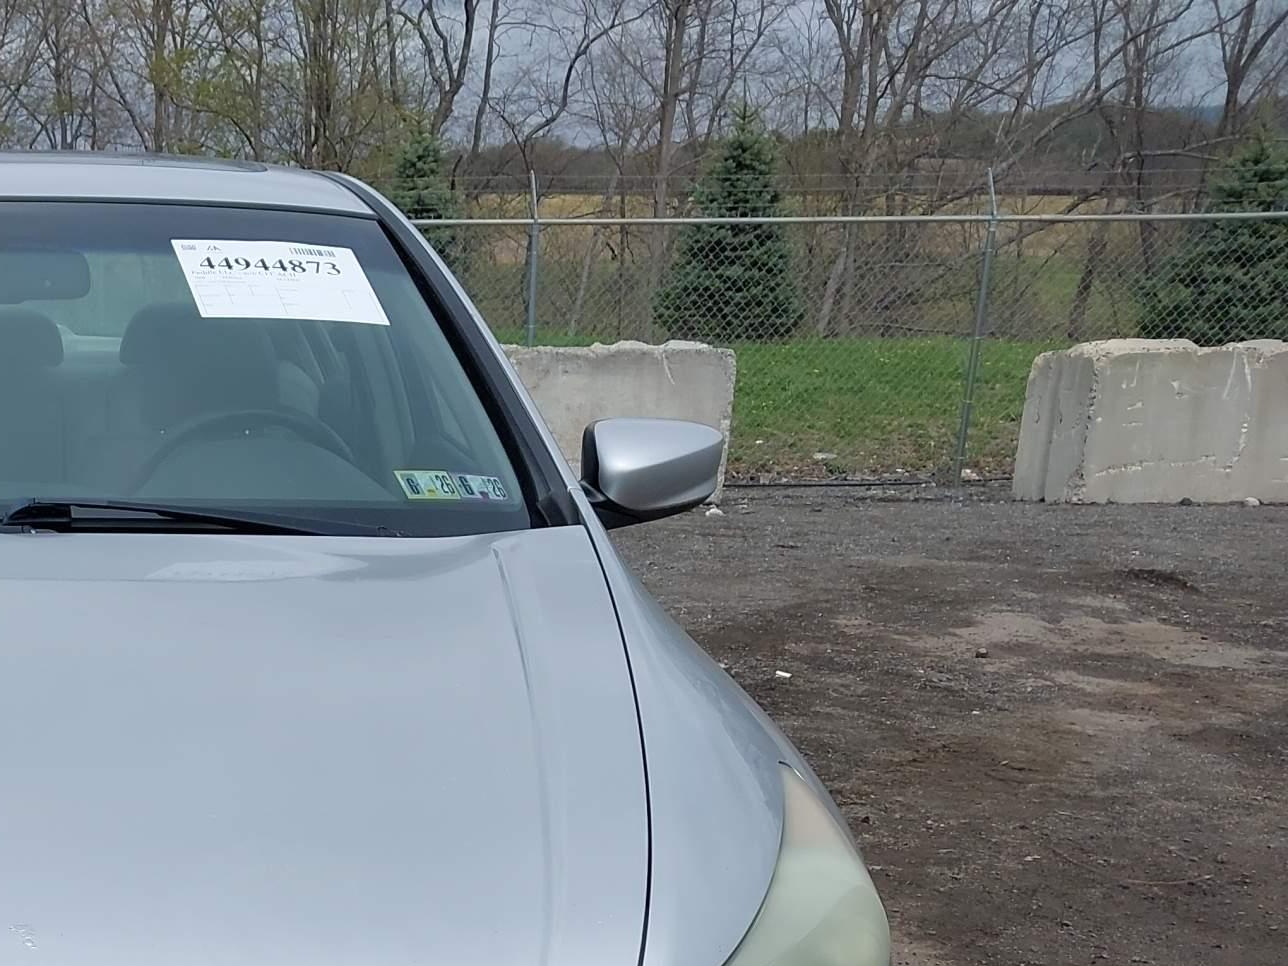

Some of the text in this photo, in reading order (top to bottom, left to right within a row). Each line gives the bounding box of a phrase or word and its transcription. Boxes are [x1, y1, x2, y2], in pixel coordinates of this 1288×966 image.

[199, 256, 341, 276] 44944873
[434, 474, 456, 495] 26
[458, 475, 506, 498] 6 26
